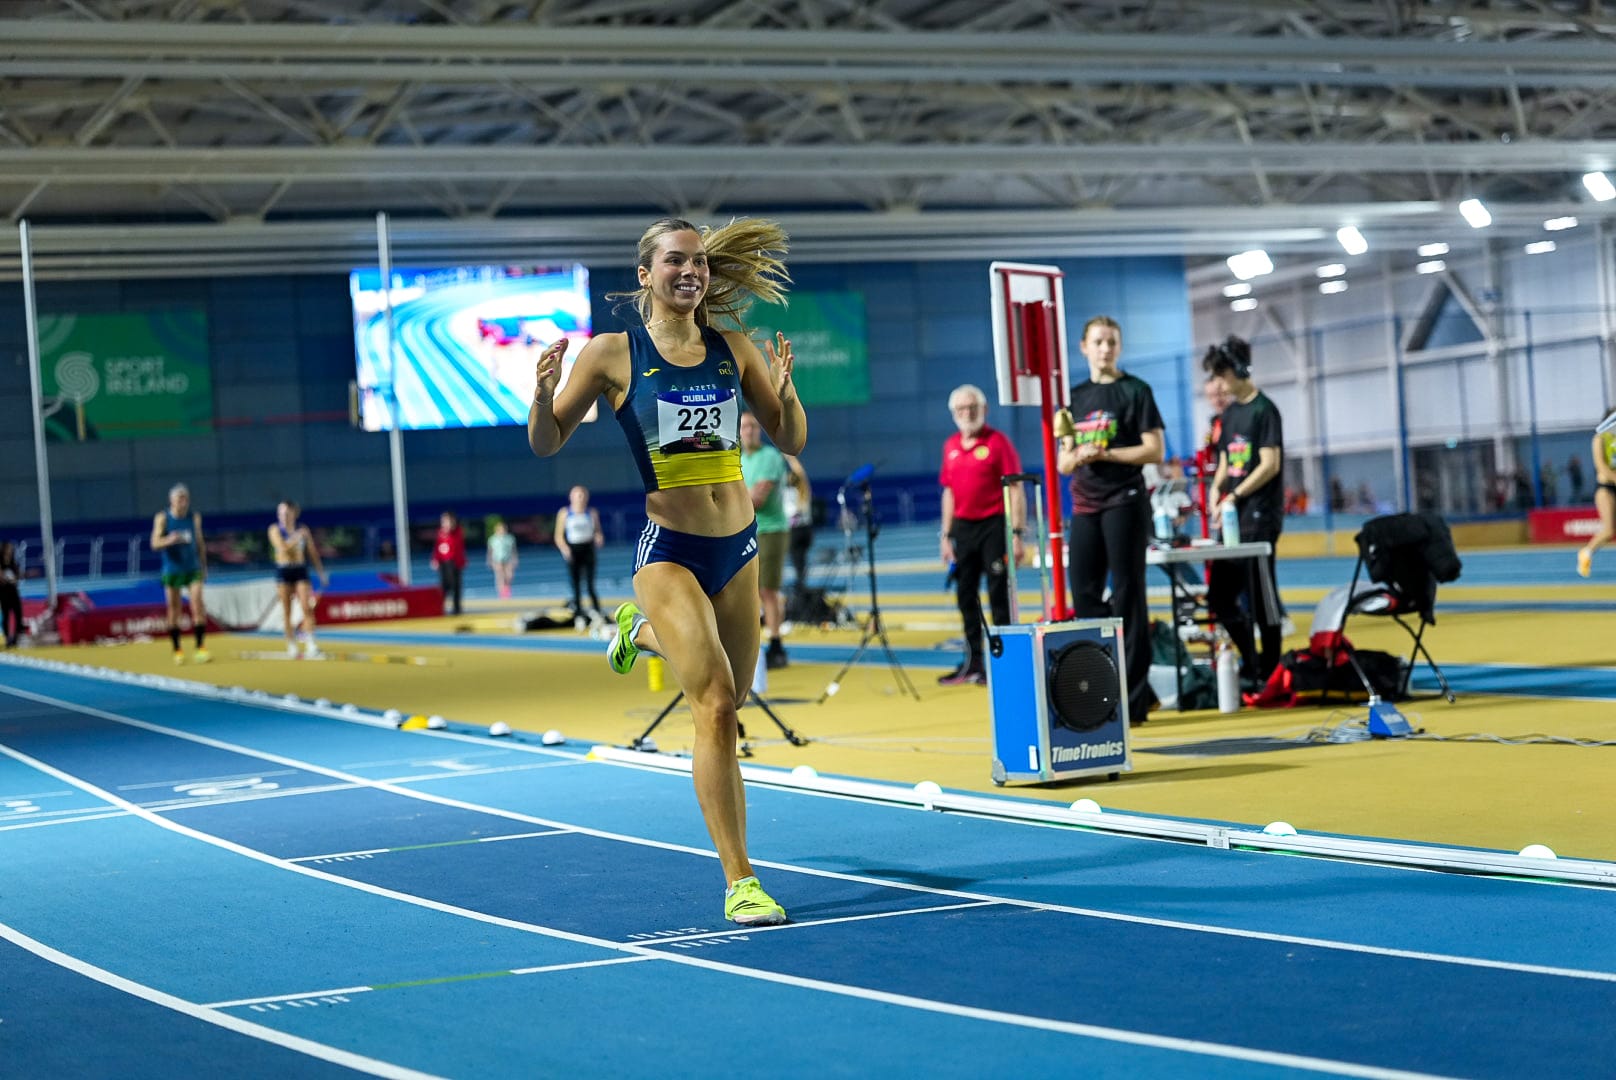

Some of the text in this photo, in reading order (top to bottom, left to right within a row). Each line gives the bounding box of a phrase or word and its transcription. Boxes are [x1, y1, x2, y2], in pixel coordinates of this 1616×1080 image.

[105, 356, 164, 375] SPORT
[106, 374, 188, 395] IRELAND
[682, 393, 716, 403] DUBLIN
[678, 407, 722, 431] 223
[1052, 741, 1123, 763] TimeTronics
